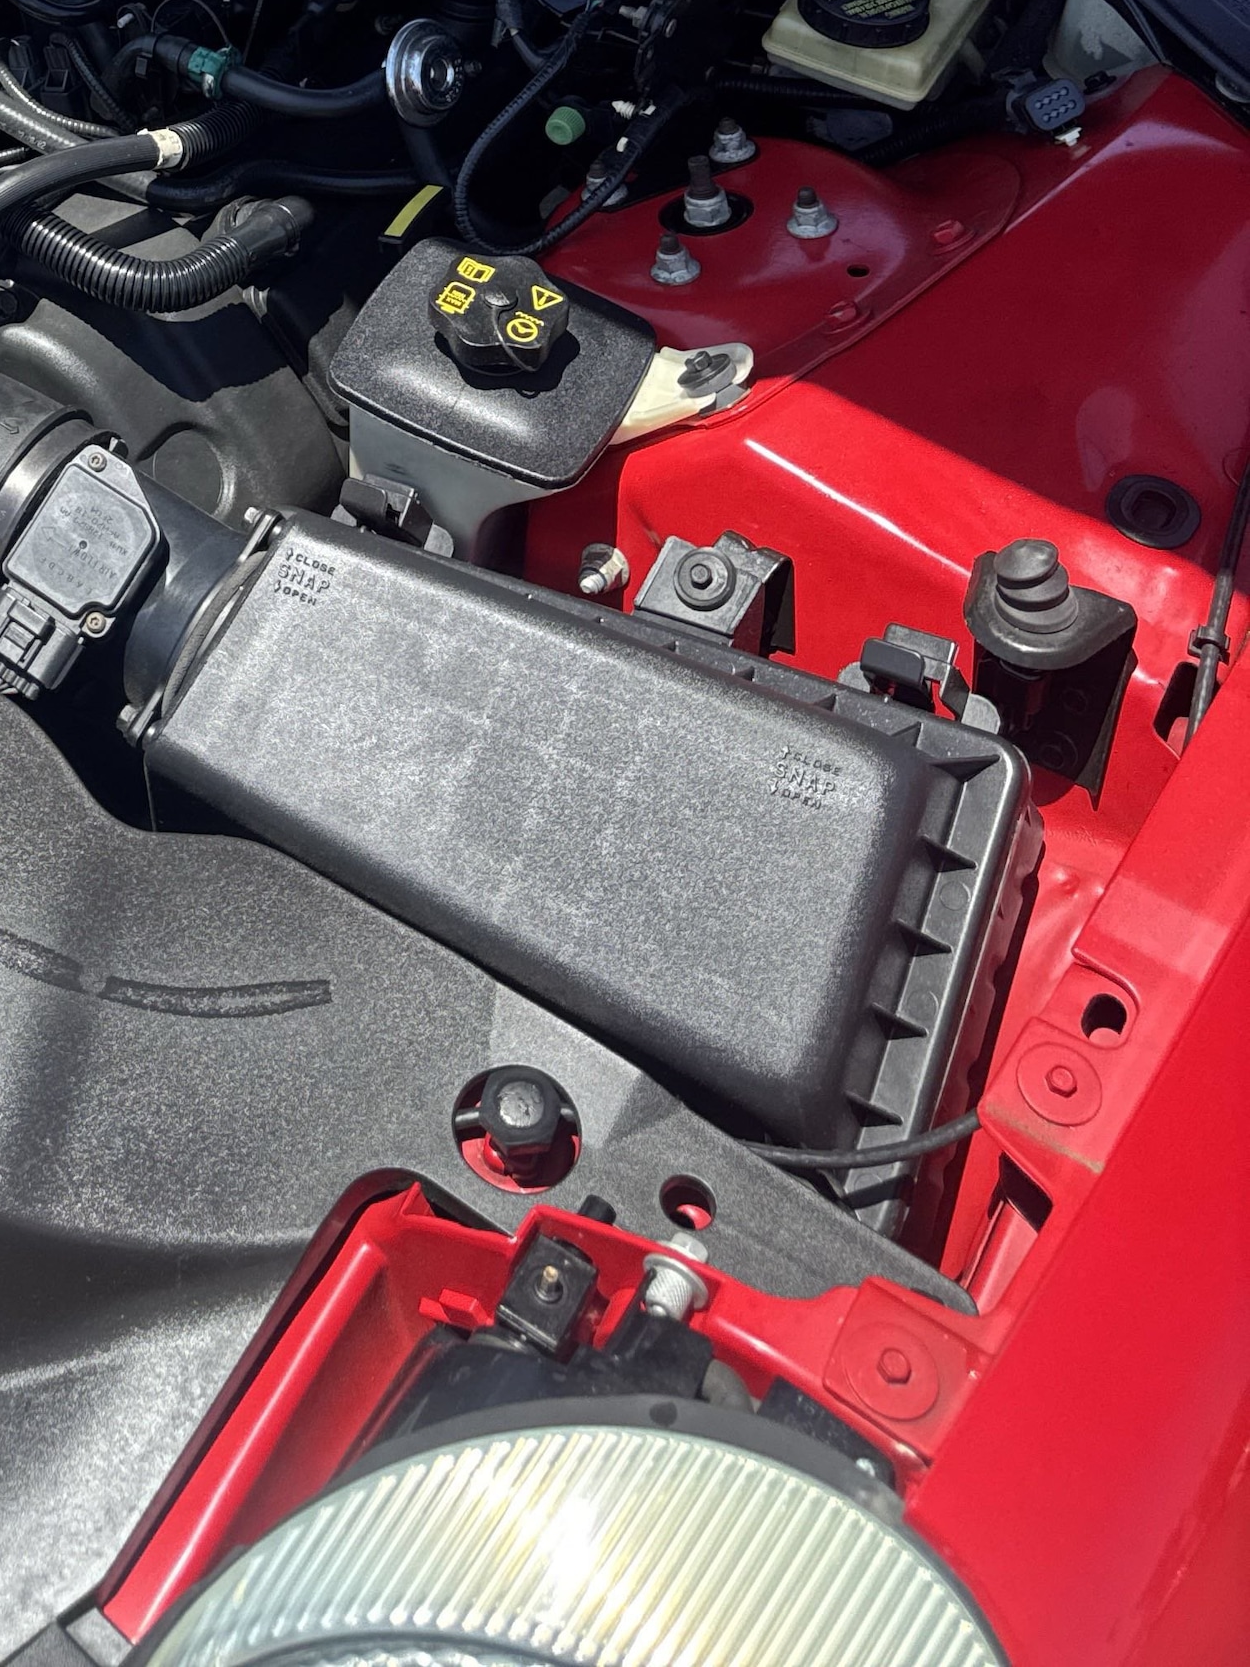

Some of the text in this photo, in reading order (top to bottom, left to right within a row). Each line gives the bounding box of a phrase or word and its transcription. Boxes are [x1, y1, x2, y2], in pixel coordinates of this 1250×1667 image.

[295, 553, 336, 576] CLOSE
[278, 564, 330, 593] SNAP
[283, 586, 317, 606] OPEN
[793, 752, 841, 776] CLOSE
[774, 761, 835, 795] SNAP
[782, 788, 822, 809] OPEN
